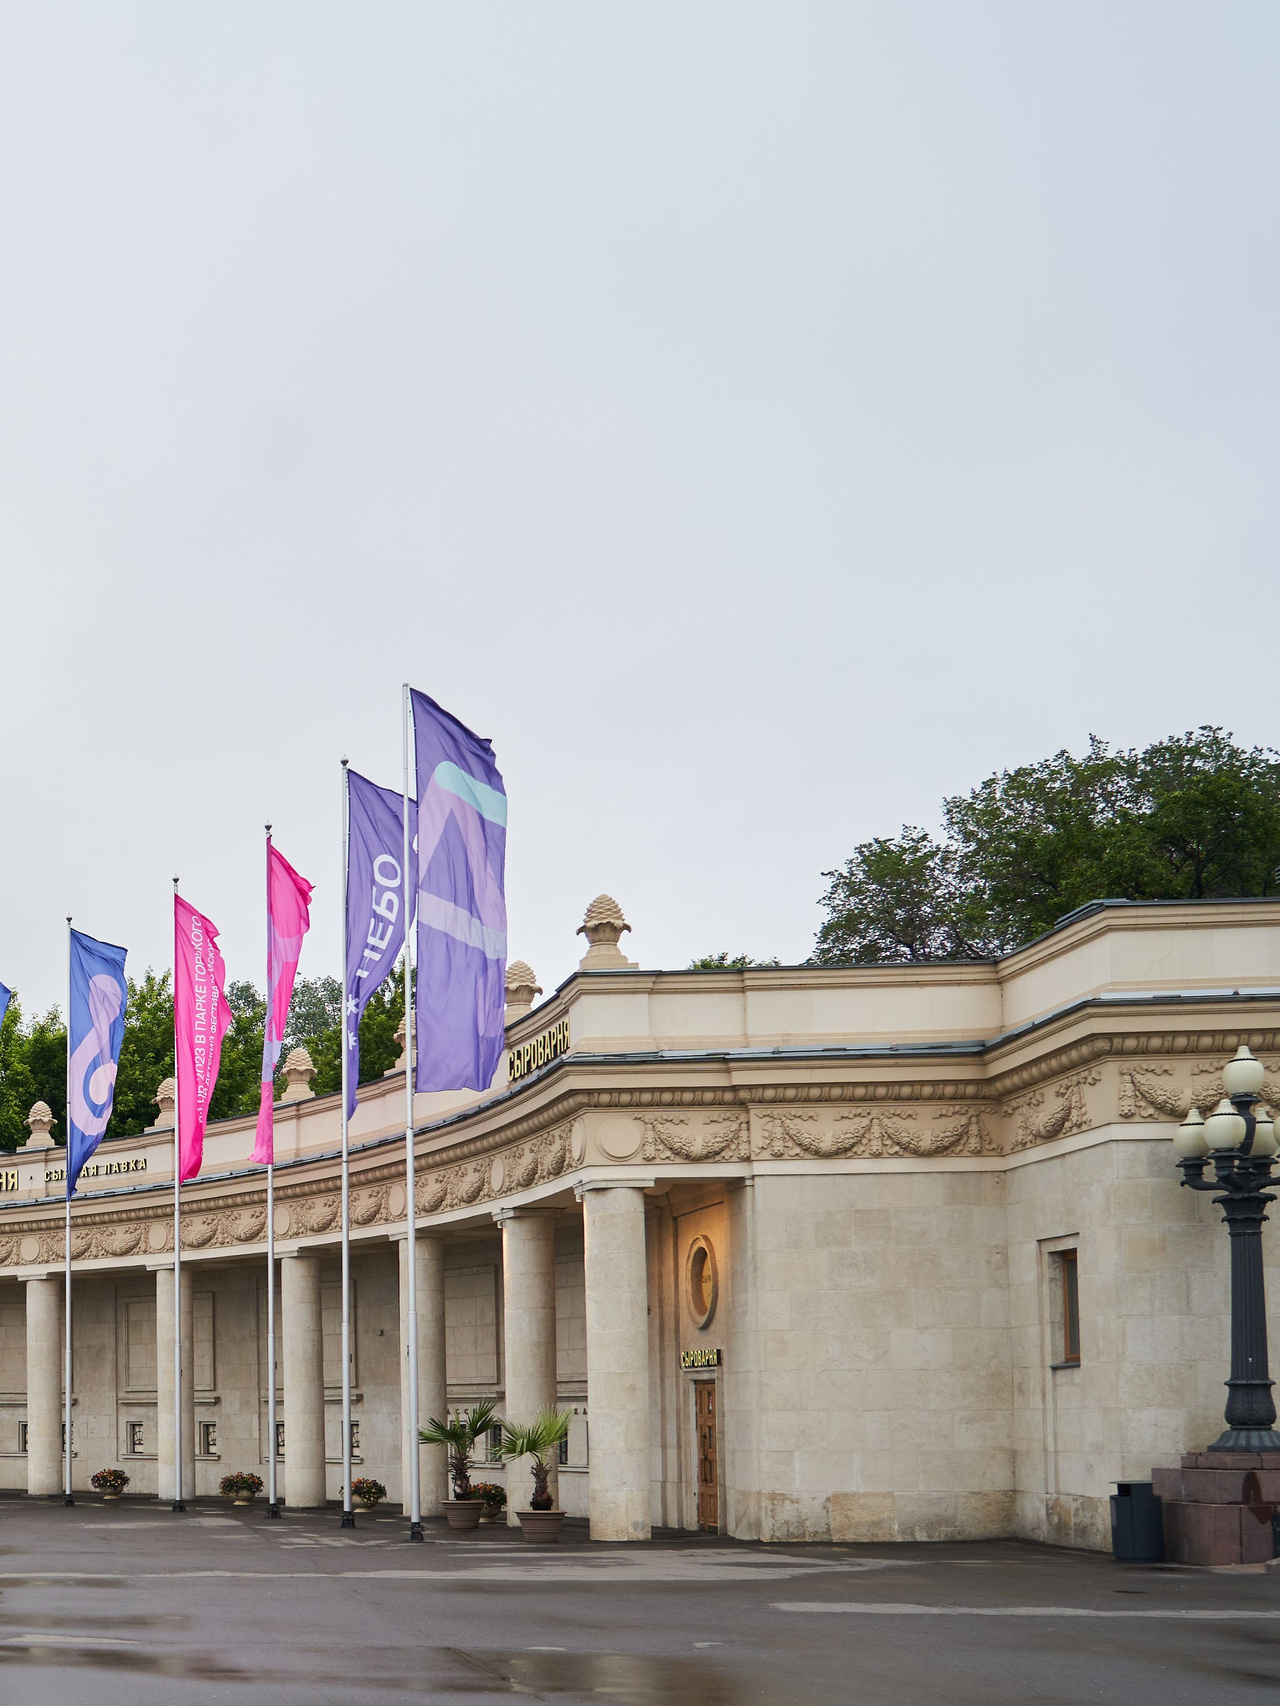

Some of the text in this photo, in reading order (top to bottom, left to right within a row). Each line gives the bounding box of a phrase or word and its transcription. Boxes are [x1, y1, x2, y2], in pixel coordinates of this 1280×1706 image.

[356, 853, 402, 979] НЕБО
[195, 985, 207, 1031] ПАРКЕ
[507, 1017, 571, 1082] СЫРОВАРНЯ
[44, 1159, 148, 1182] СЫАЯ ЛАВКА
[681, 1349, 718, 1368] СЫРОВАРНЯ
